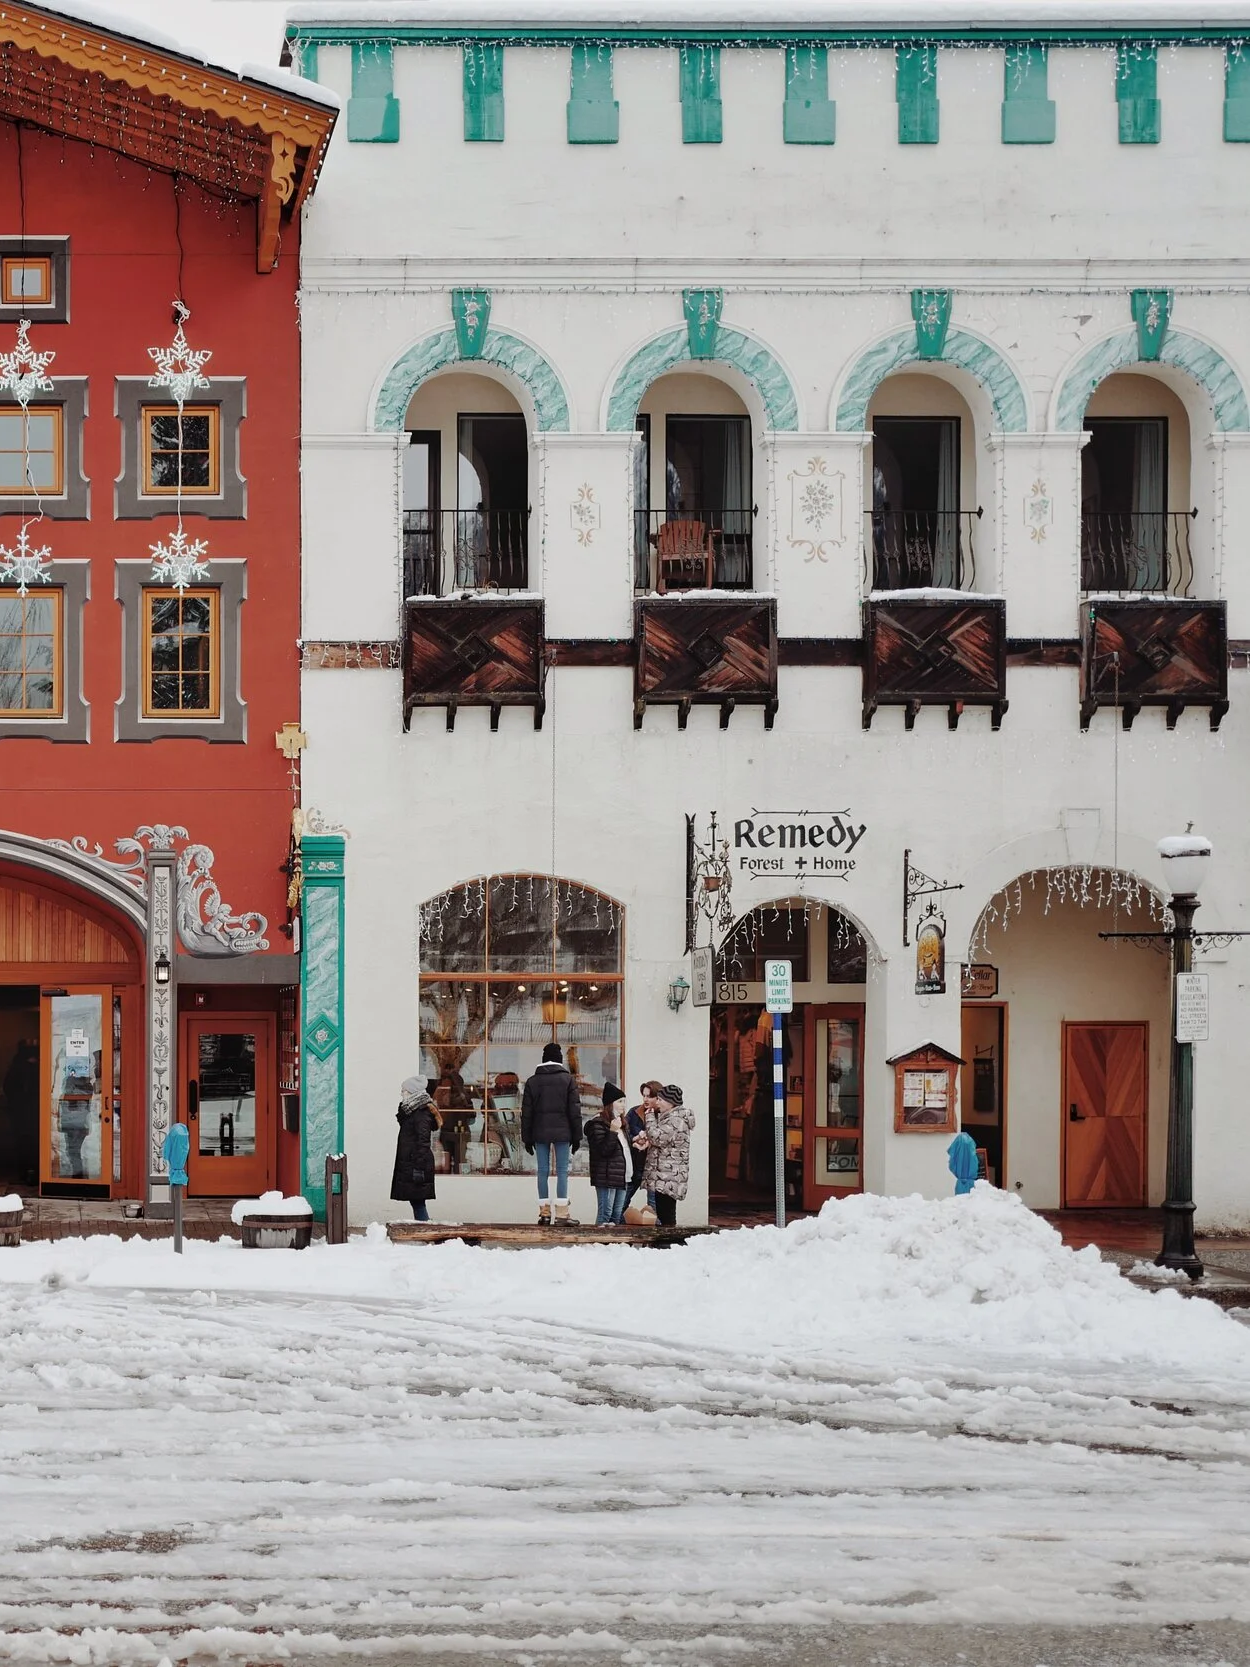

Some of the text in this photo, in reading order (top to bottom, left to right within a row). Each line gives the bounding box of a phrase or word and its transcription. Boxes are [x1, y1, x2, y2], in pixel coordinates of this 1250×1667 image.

[734, 815, 868, 854] Remedy
[739, 856, 785, 870] Forest
[813, 856, 857, 870] Home
[771, 965, 786, 977] 30
[768, 979, 789, 987] MINUTE
[718, 983, 748, 1001] 815
[771, 988, 786, 996] LIMIT
